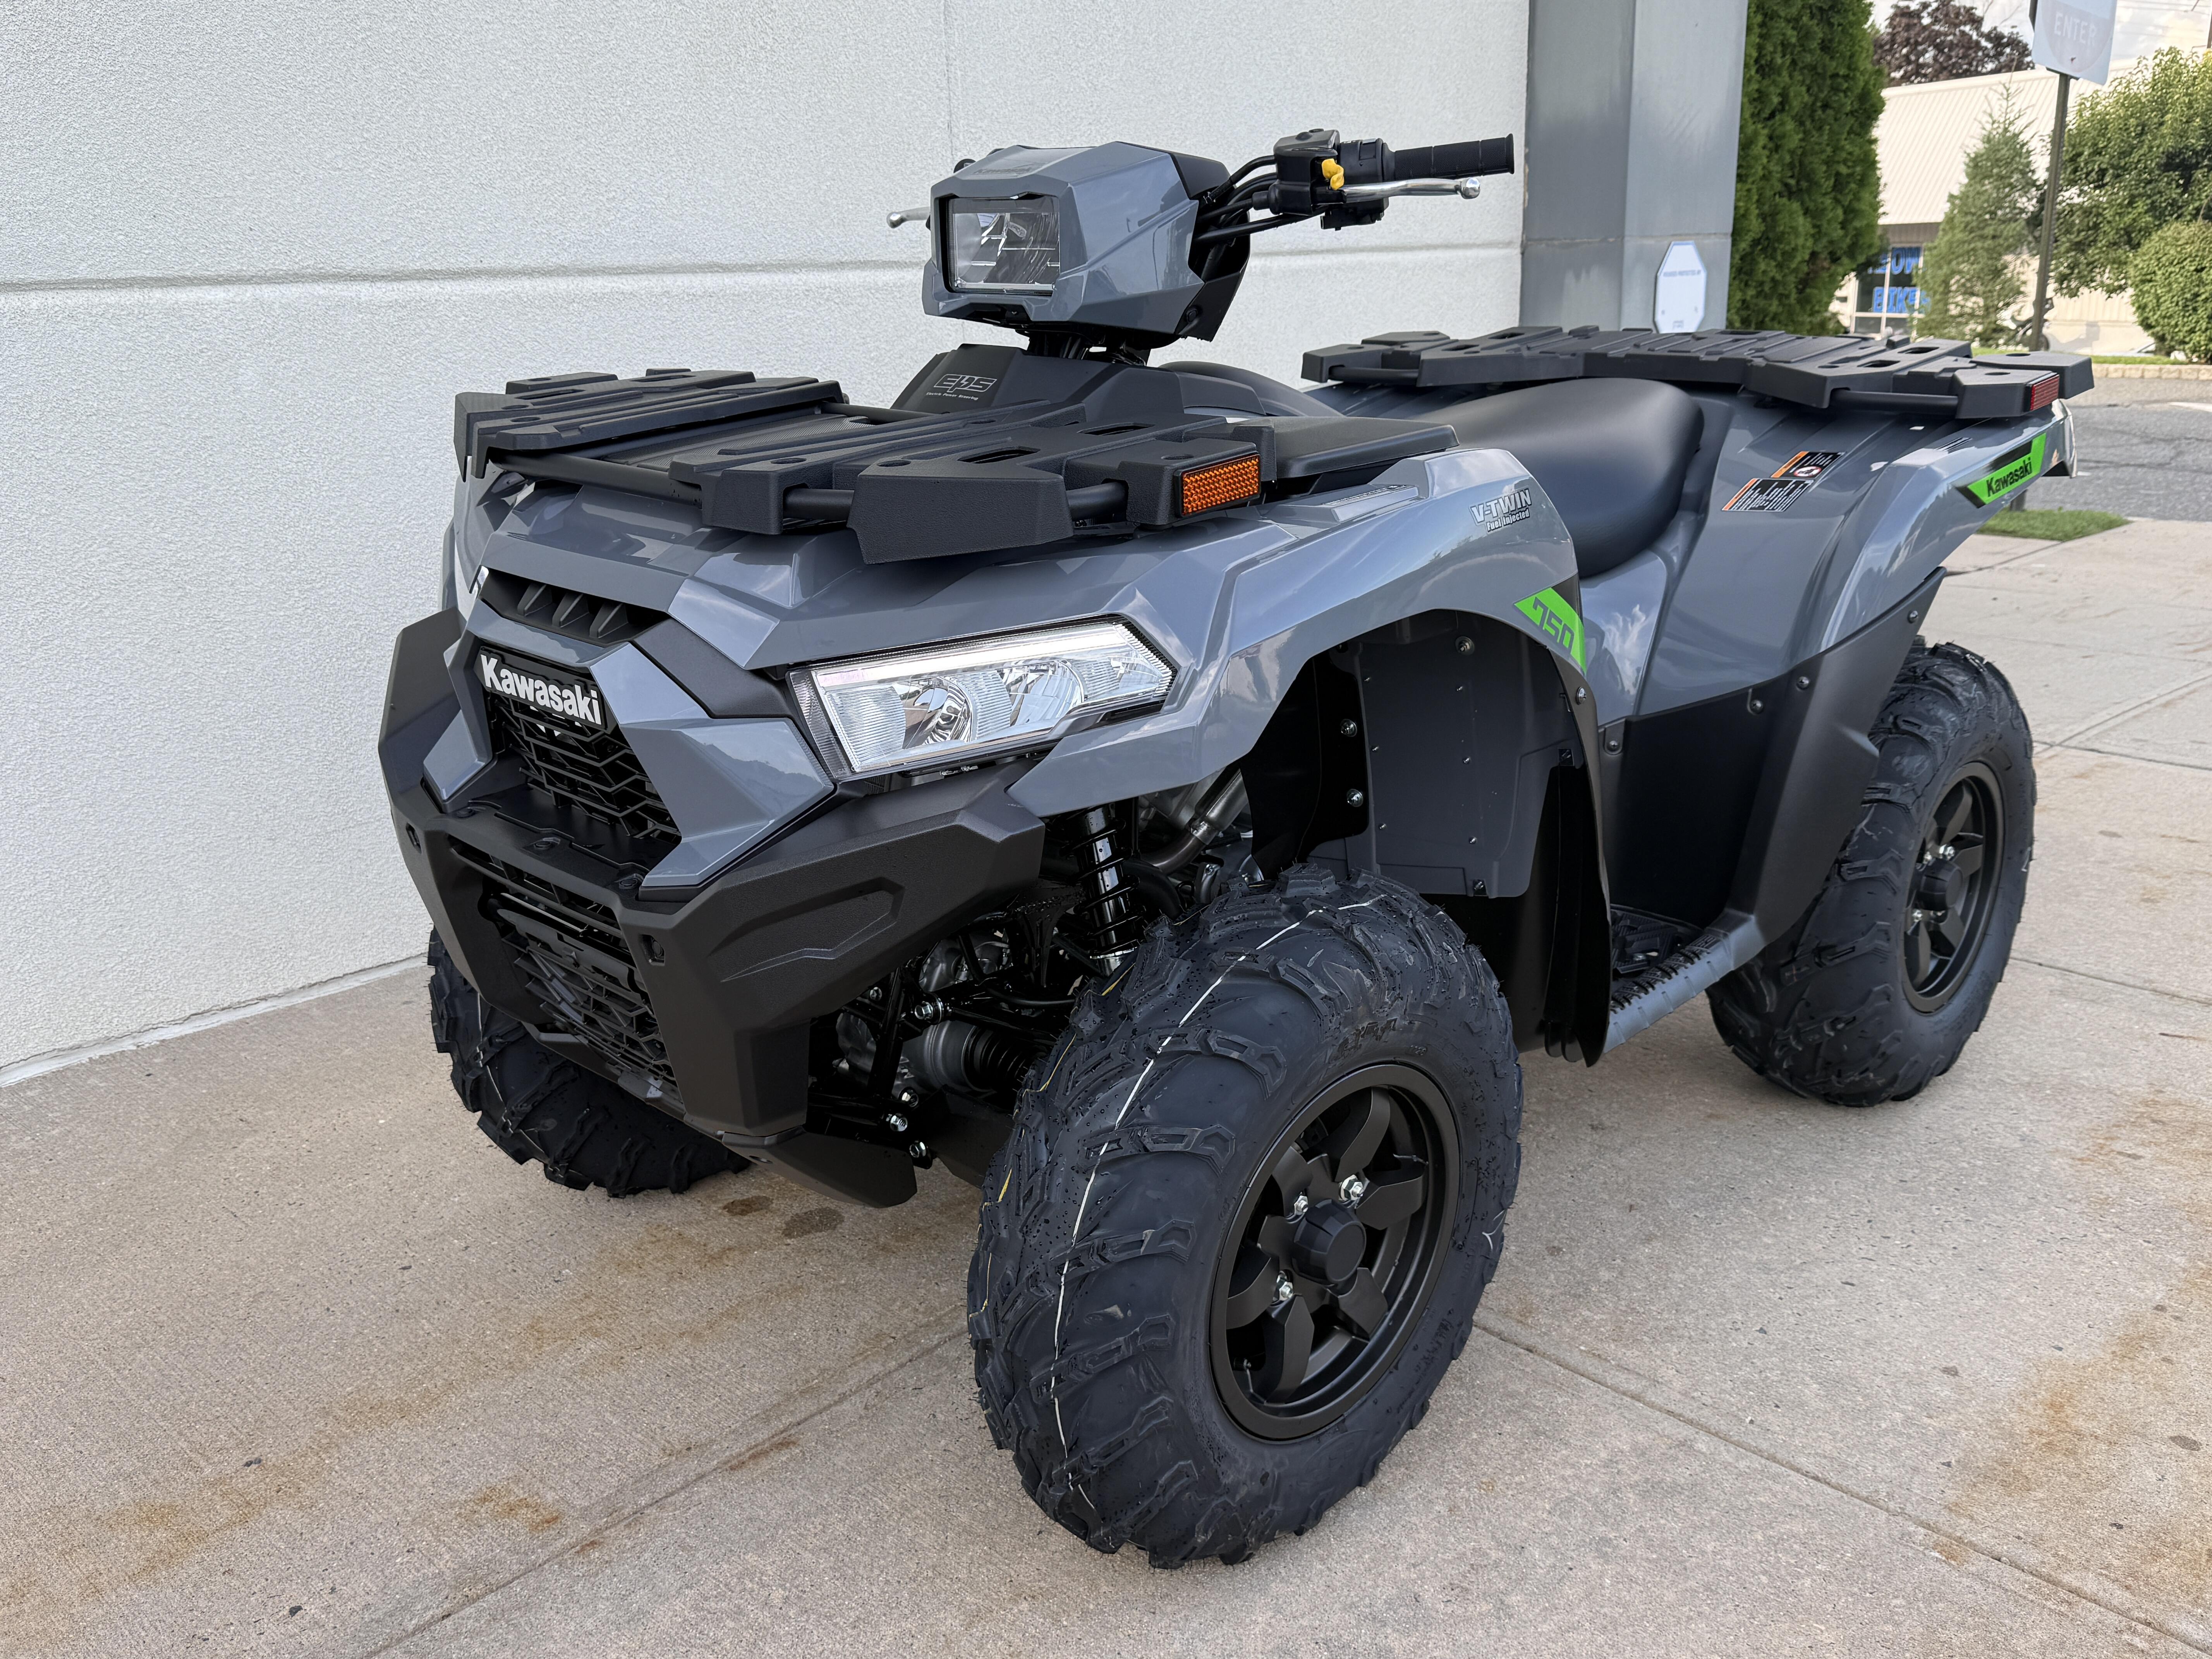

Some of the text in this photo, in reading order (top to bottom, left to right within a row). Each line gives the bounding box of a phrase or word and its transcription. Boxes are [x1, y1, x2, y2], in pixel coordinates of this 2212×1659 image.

[2054, 11, 2097, 47] ENTER
[933, 374, 997, 393] EPS
[1986, 457, 2032, 497] Kawasaki
[1470, 488, 1532, 523] V-TWIN
[1486, 507, 1530, 532] Fuel Injected
[1532, 596, 1575, 654] 750
[481, 654, 601, 725] Kawasaki
